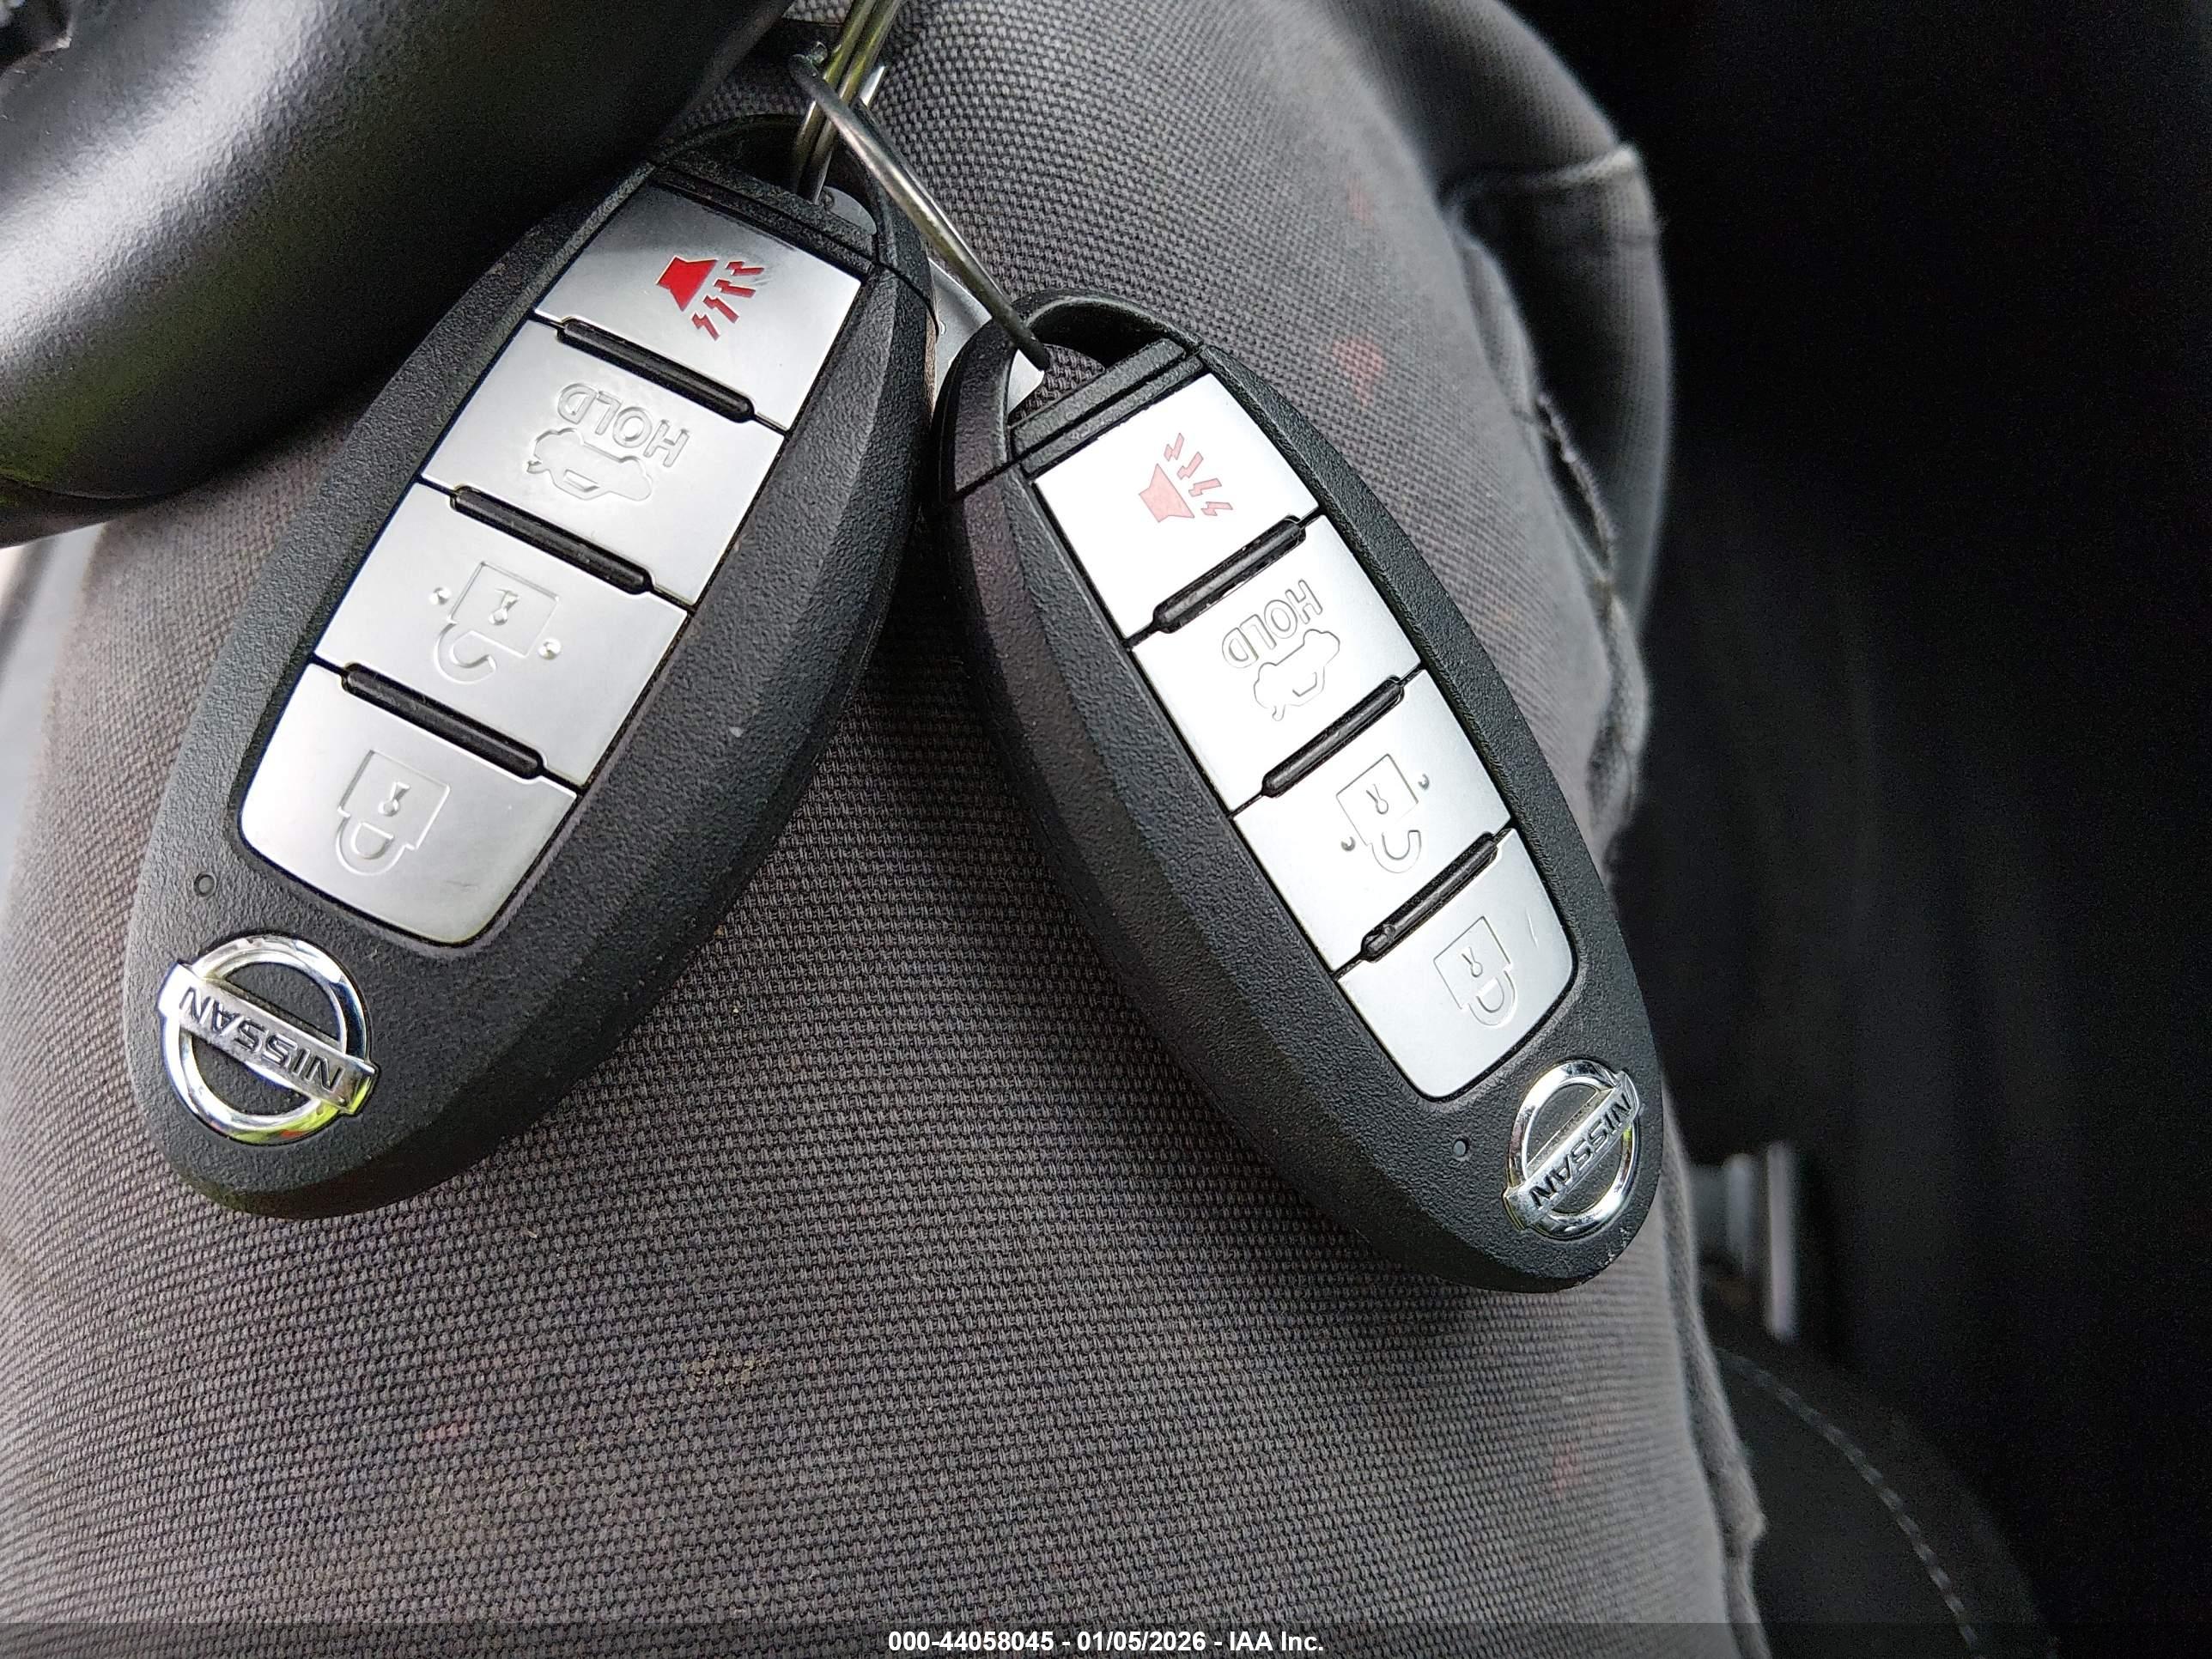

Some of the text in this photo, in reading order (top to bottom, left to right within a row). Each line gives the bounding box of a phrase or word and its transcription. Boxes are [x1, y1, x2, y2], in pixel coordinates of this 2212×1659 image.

[557, 383, 690, 468] HOLD
[1221, 579, 1323, 668] HOLD
[179, 987, 344, 1092] NISSAN
[1528, 1092, 1633, 1211] NISSAN
